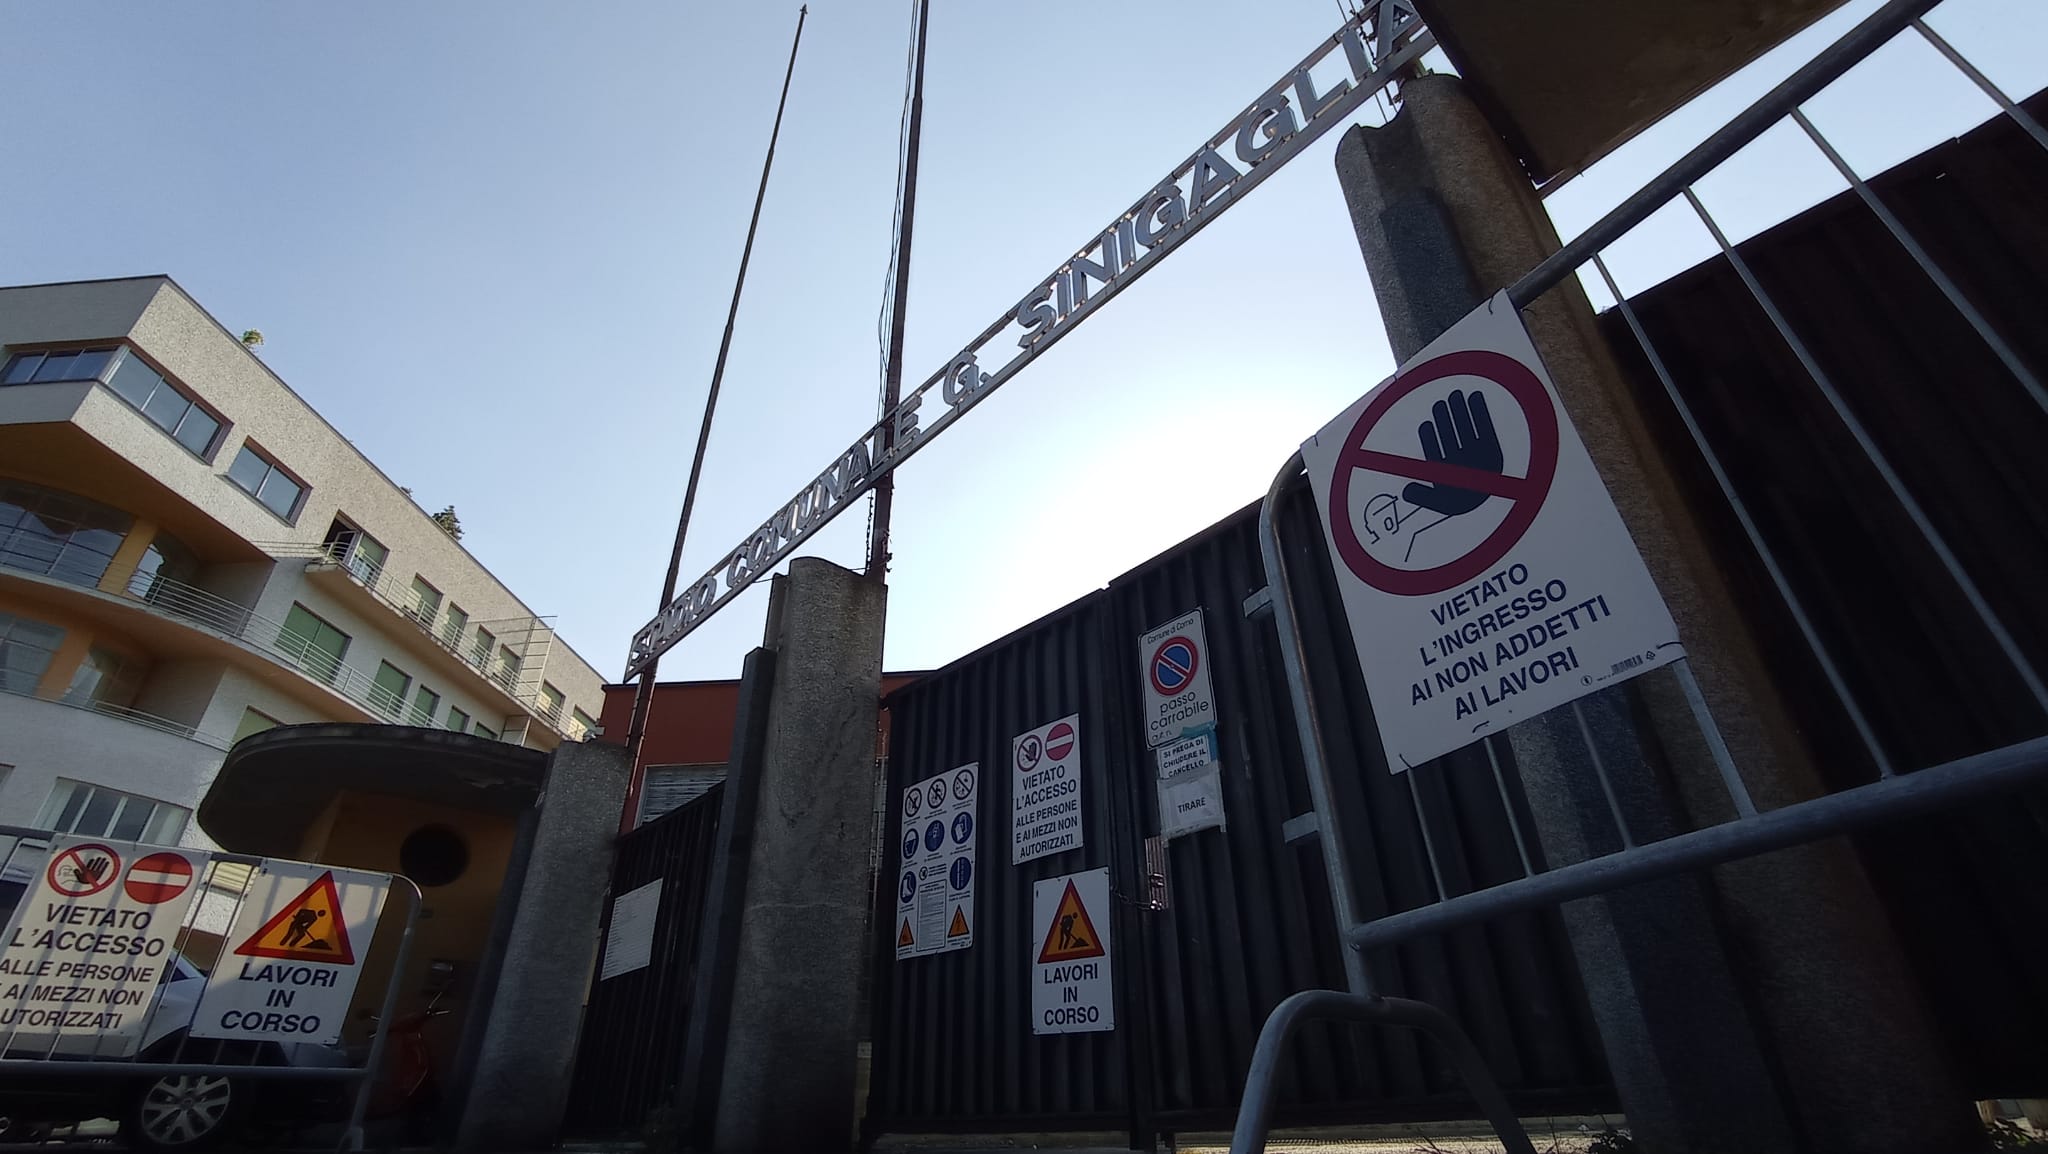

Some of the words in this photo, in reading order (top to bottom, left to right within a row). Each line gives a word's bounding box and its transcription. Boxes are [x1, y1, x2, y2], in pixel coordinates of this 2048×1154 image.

[726, 396, 922, 589] COMUNALE
[1017, 0, 1421, 349] SINIGAGLIA
[1431, 563, 1528, 626] VIETATO
[1147, 627, 1170, 644] Comune
[1175, 618, 1194, 632] Como
[1419, 579, 1567, 667] L'INGRESSO
[1410, 679, 1433, 705] AI
[1435, 652, 1489, 692] NON
[1495, 595, 1611, 667] ADDETTI
[1455, 692, 1478, 720] AI
[1481, 647, 1579, 707] LAVORI
[1150, 700, 1209, 731] carrabile
[1160, 691, 1196, 716] passo
[1163, 750, 1170, 759] SI
[1172, 741, 1195, 757] PREGA
[1195, 738, 1204, 748] DI
[1163, 751, 1198, 769] CHIUDERE
[1199, 748, 1207, 757] IL
[1022, 764, 1065, 791] VIETATO
[1167, 760, 1205, 779] CANCELLO
[1016, 779, 1077, 811] L'ACCESSO
[1178, 797, 1206, 814] TIRARE
[1016, 813, 1035, 829] ALLE
[1036, 800, 1078, 822] PERSONE
[1016, 832, 1022, 844] E
[1023, 829, 1031, 842] AI
[1032, 821, 1056, 839] MEZZI
[1058, 816, 1078, 831] NON
[1019, 833, 1074, 859] AUTORIZZATI
[46, 903, 152, 930] VIETATO
[9, 928, 165, 957] L'ACCESSO
[0, 959, 54, 976] ALLE
[56, 962, 154, 982] PERSONE
[239, 963, 338, 988] LAVORI
[1044, 963, 1099, 984] LAVORI
[4, 984, 28, 1000] AI
[30, 985, 96, 1003] MEZZI
[98, 989, 144, 1006] NON
[266, 988, 296, 1008] IN
[1063, 986, 1078, 1003] IN
[0, 1008, 123, 1029] UTORIZZATI
[220, 1010, 320, 1035] CORSO
[1044, 1006, 1099, 1026] CORSO
